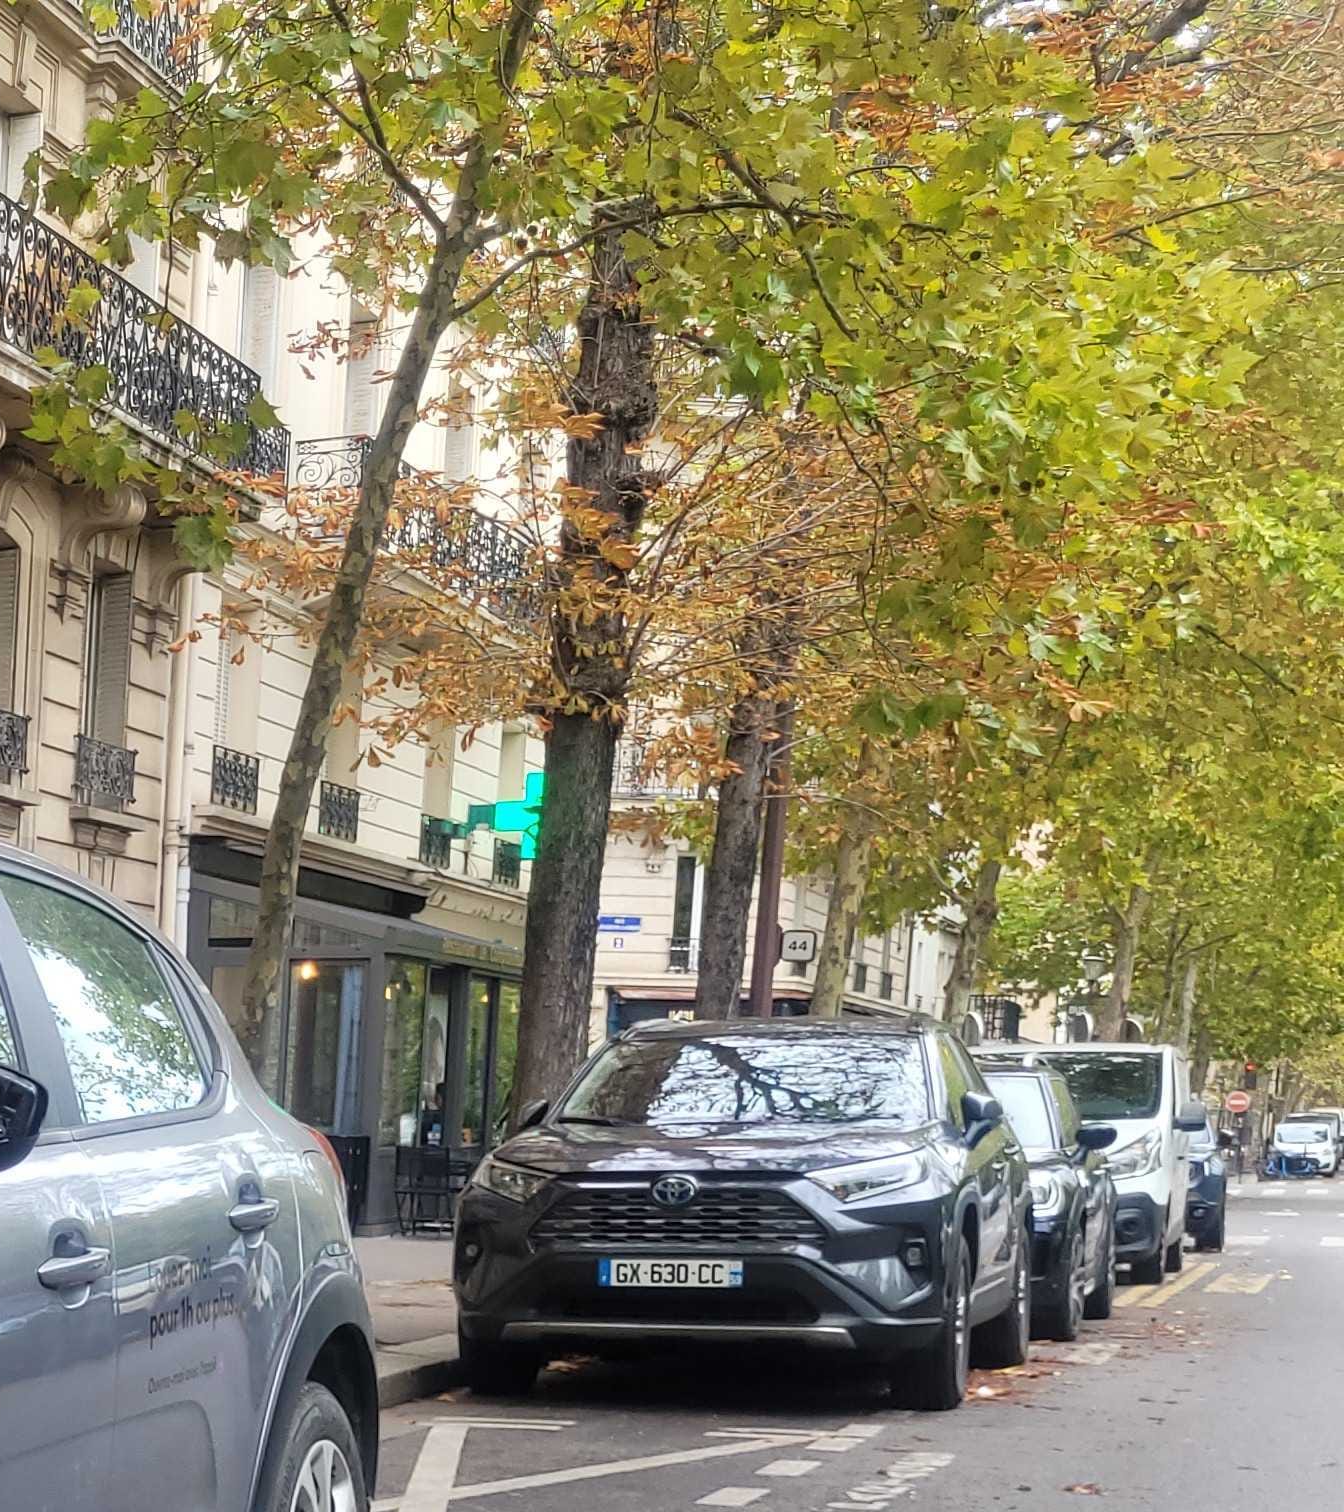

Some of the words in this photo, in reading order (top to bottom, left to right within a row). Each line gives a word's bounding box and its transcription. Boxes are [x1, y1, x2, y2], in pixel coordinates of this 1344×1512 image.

[788, 941, 808, 952] 44
[149, 1307, 179, 1351] pour
[180, 1295, 194, 1329] 1h
[196, 1301, 211, 1325] ou
